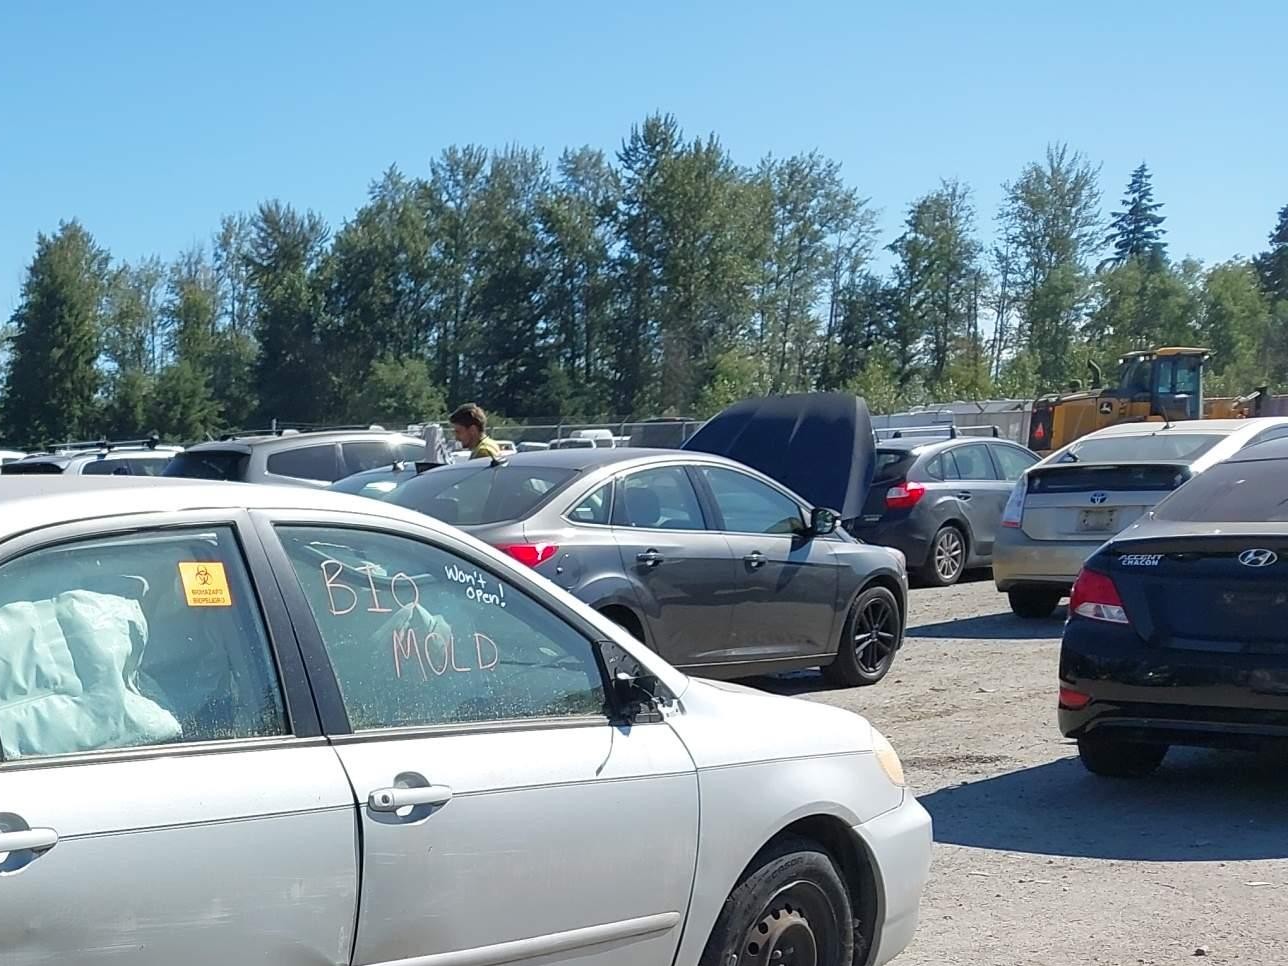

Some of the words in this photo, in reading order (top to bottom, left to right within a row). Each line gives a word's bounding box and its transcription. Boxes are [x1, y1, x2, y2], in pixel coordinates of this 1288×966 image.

[321, 560, 419, 615] BIO
[444, 564, 487, 589] Won't
[393, 628, 498, 681] MOLD
